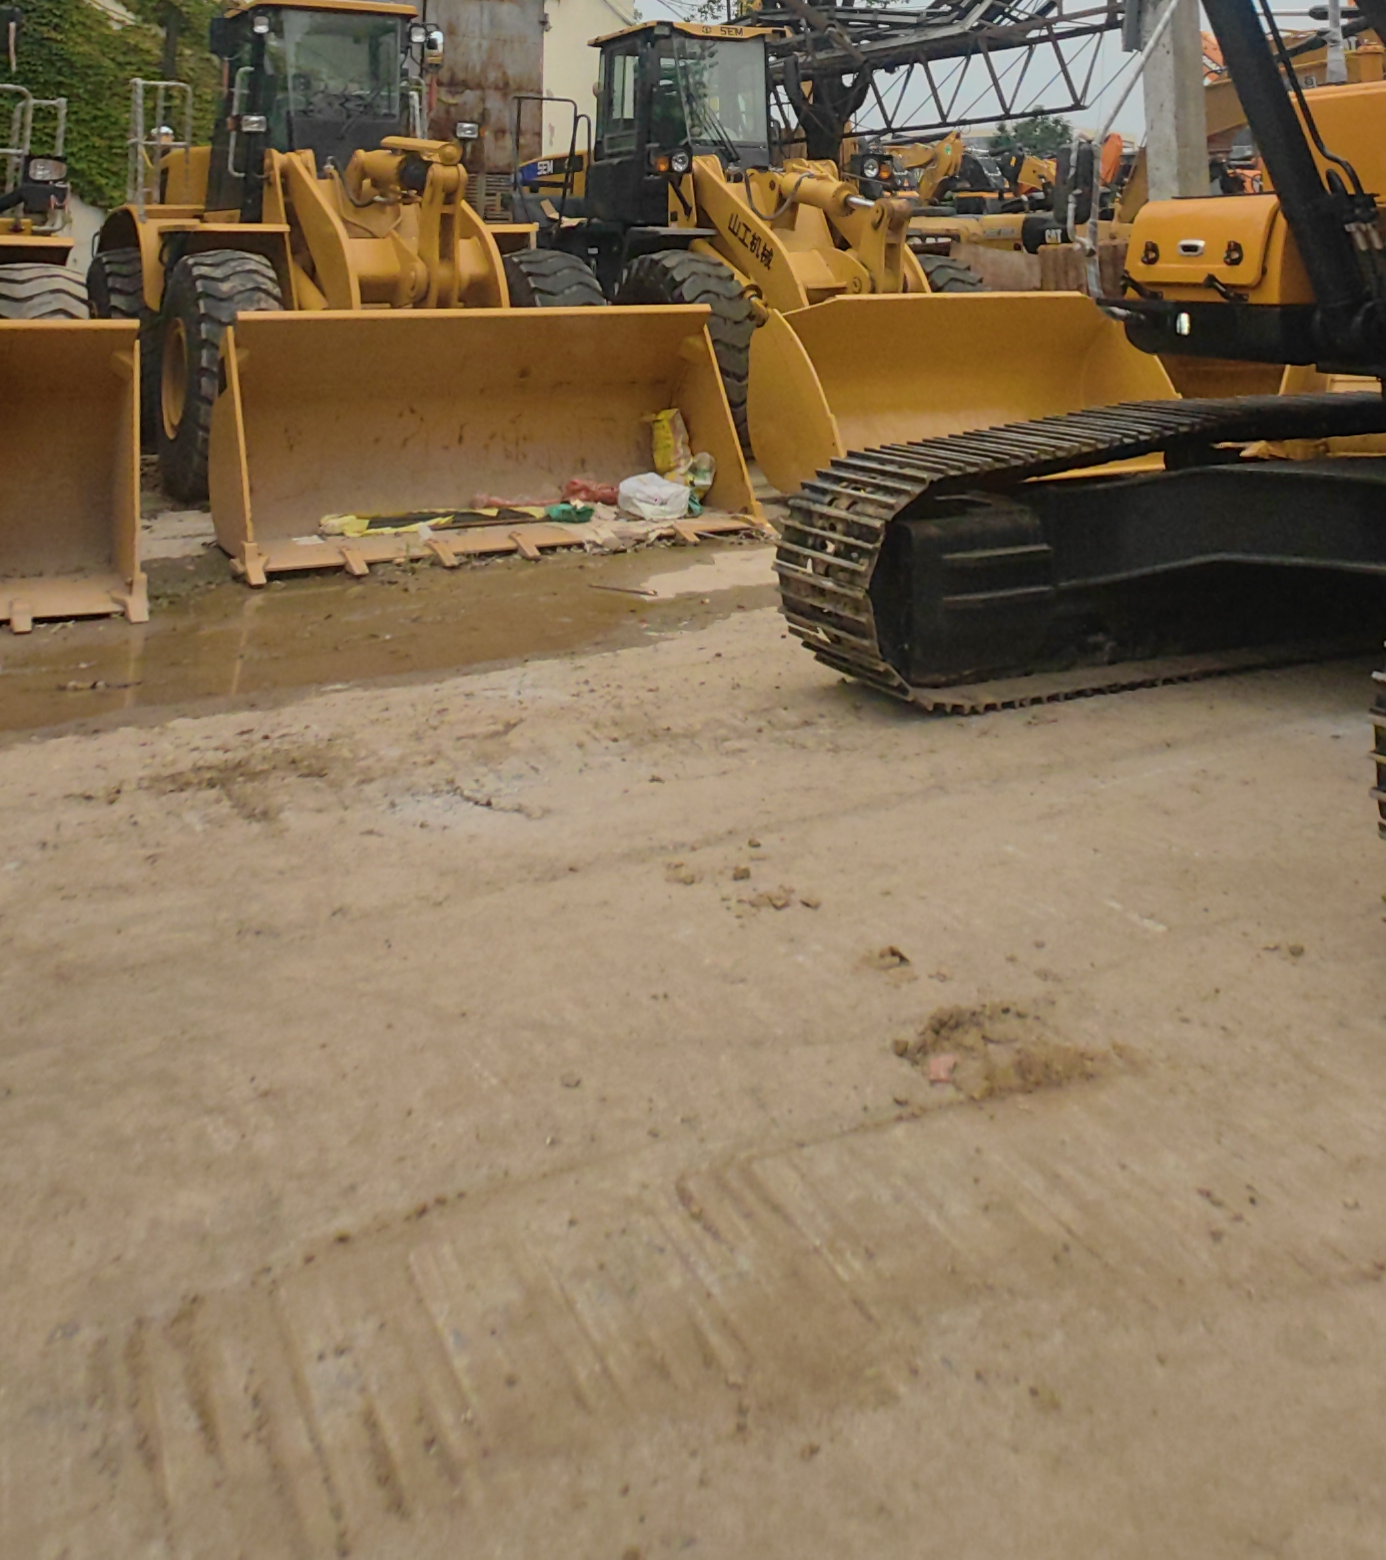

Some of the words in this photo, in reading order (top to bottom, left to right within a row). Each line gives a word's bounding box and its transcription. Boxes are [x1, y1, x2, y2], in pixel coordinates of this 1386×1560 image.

[720, 26, 744, 37] SEM
[536, 159, 554, 175] SEM
[727, 213, 774, 270] 山工机械
[1044, 228, 1062, 244] CAT
